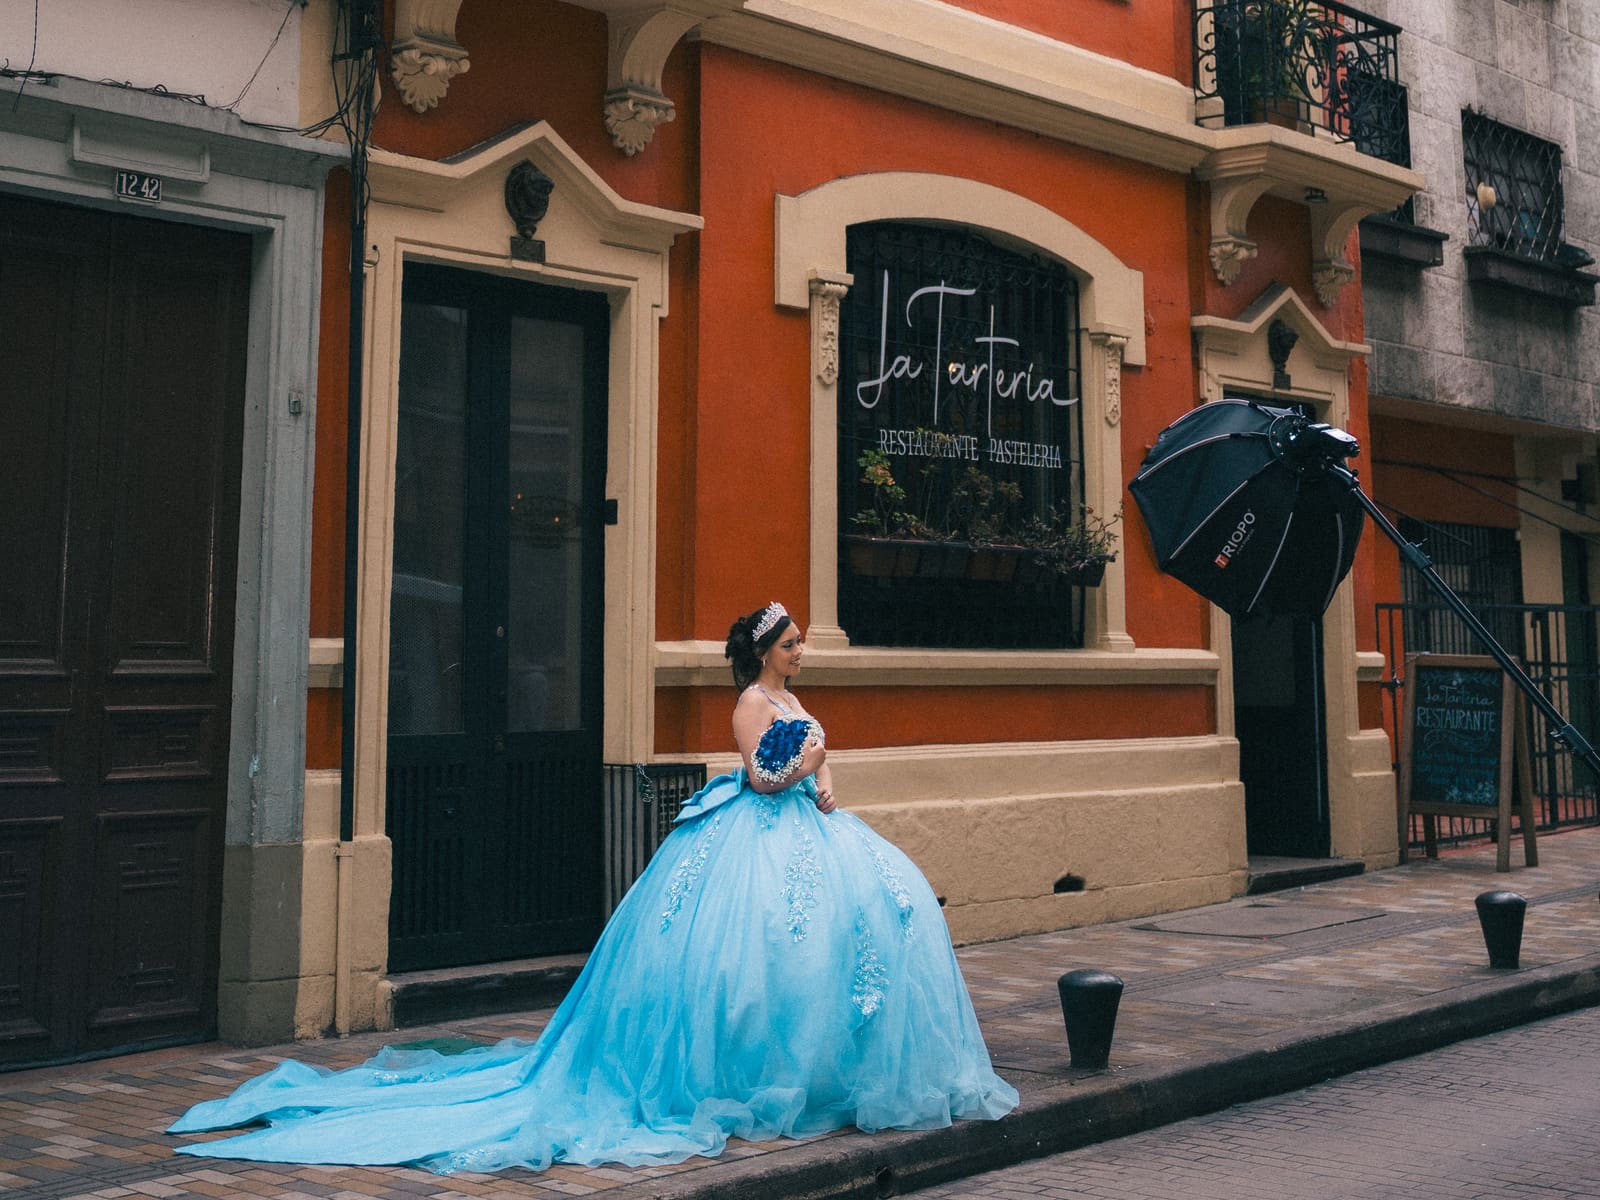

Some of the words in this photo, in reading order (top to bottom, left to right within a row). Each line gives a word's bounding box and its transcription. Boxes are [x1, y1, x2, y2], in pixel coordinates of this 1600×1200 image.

[857, 269, 924, 409] La
[879, 429, 980, 462] RESTAURANTE
[989, 438, 1063, 469] PASTELERIA
[1215, 512, 1256, 568] TRIOPO
[1416, 706, 1497, 732] RESTAURANTE
